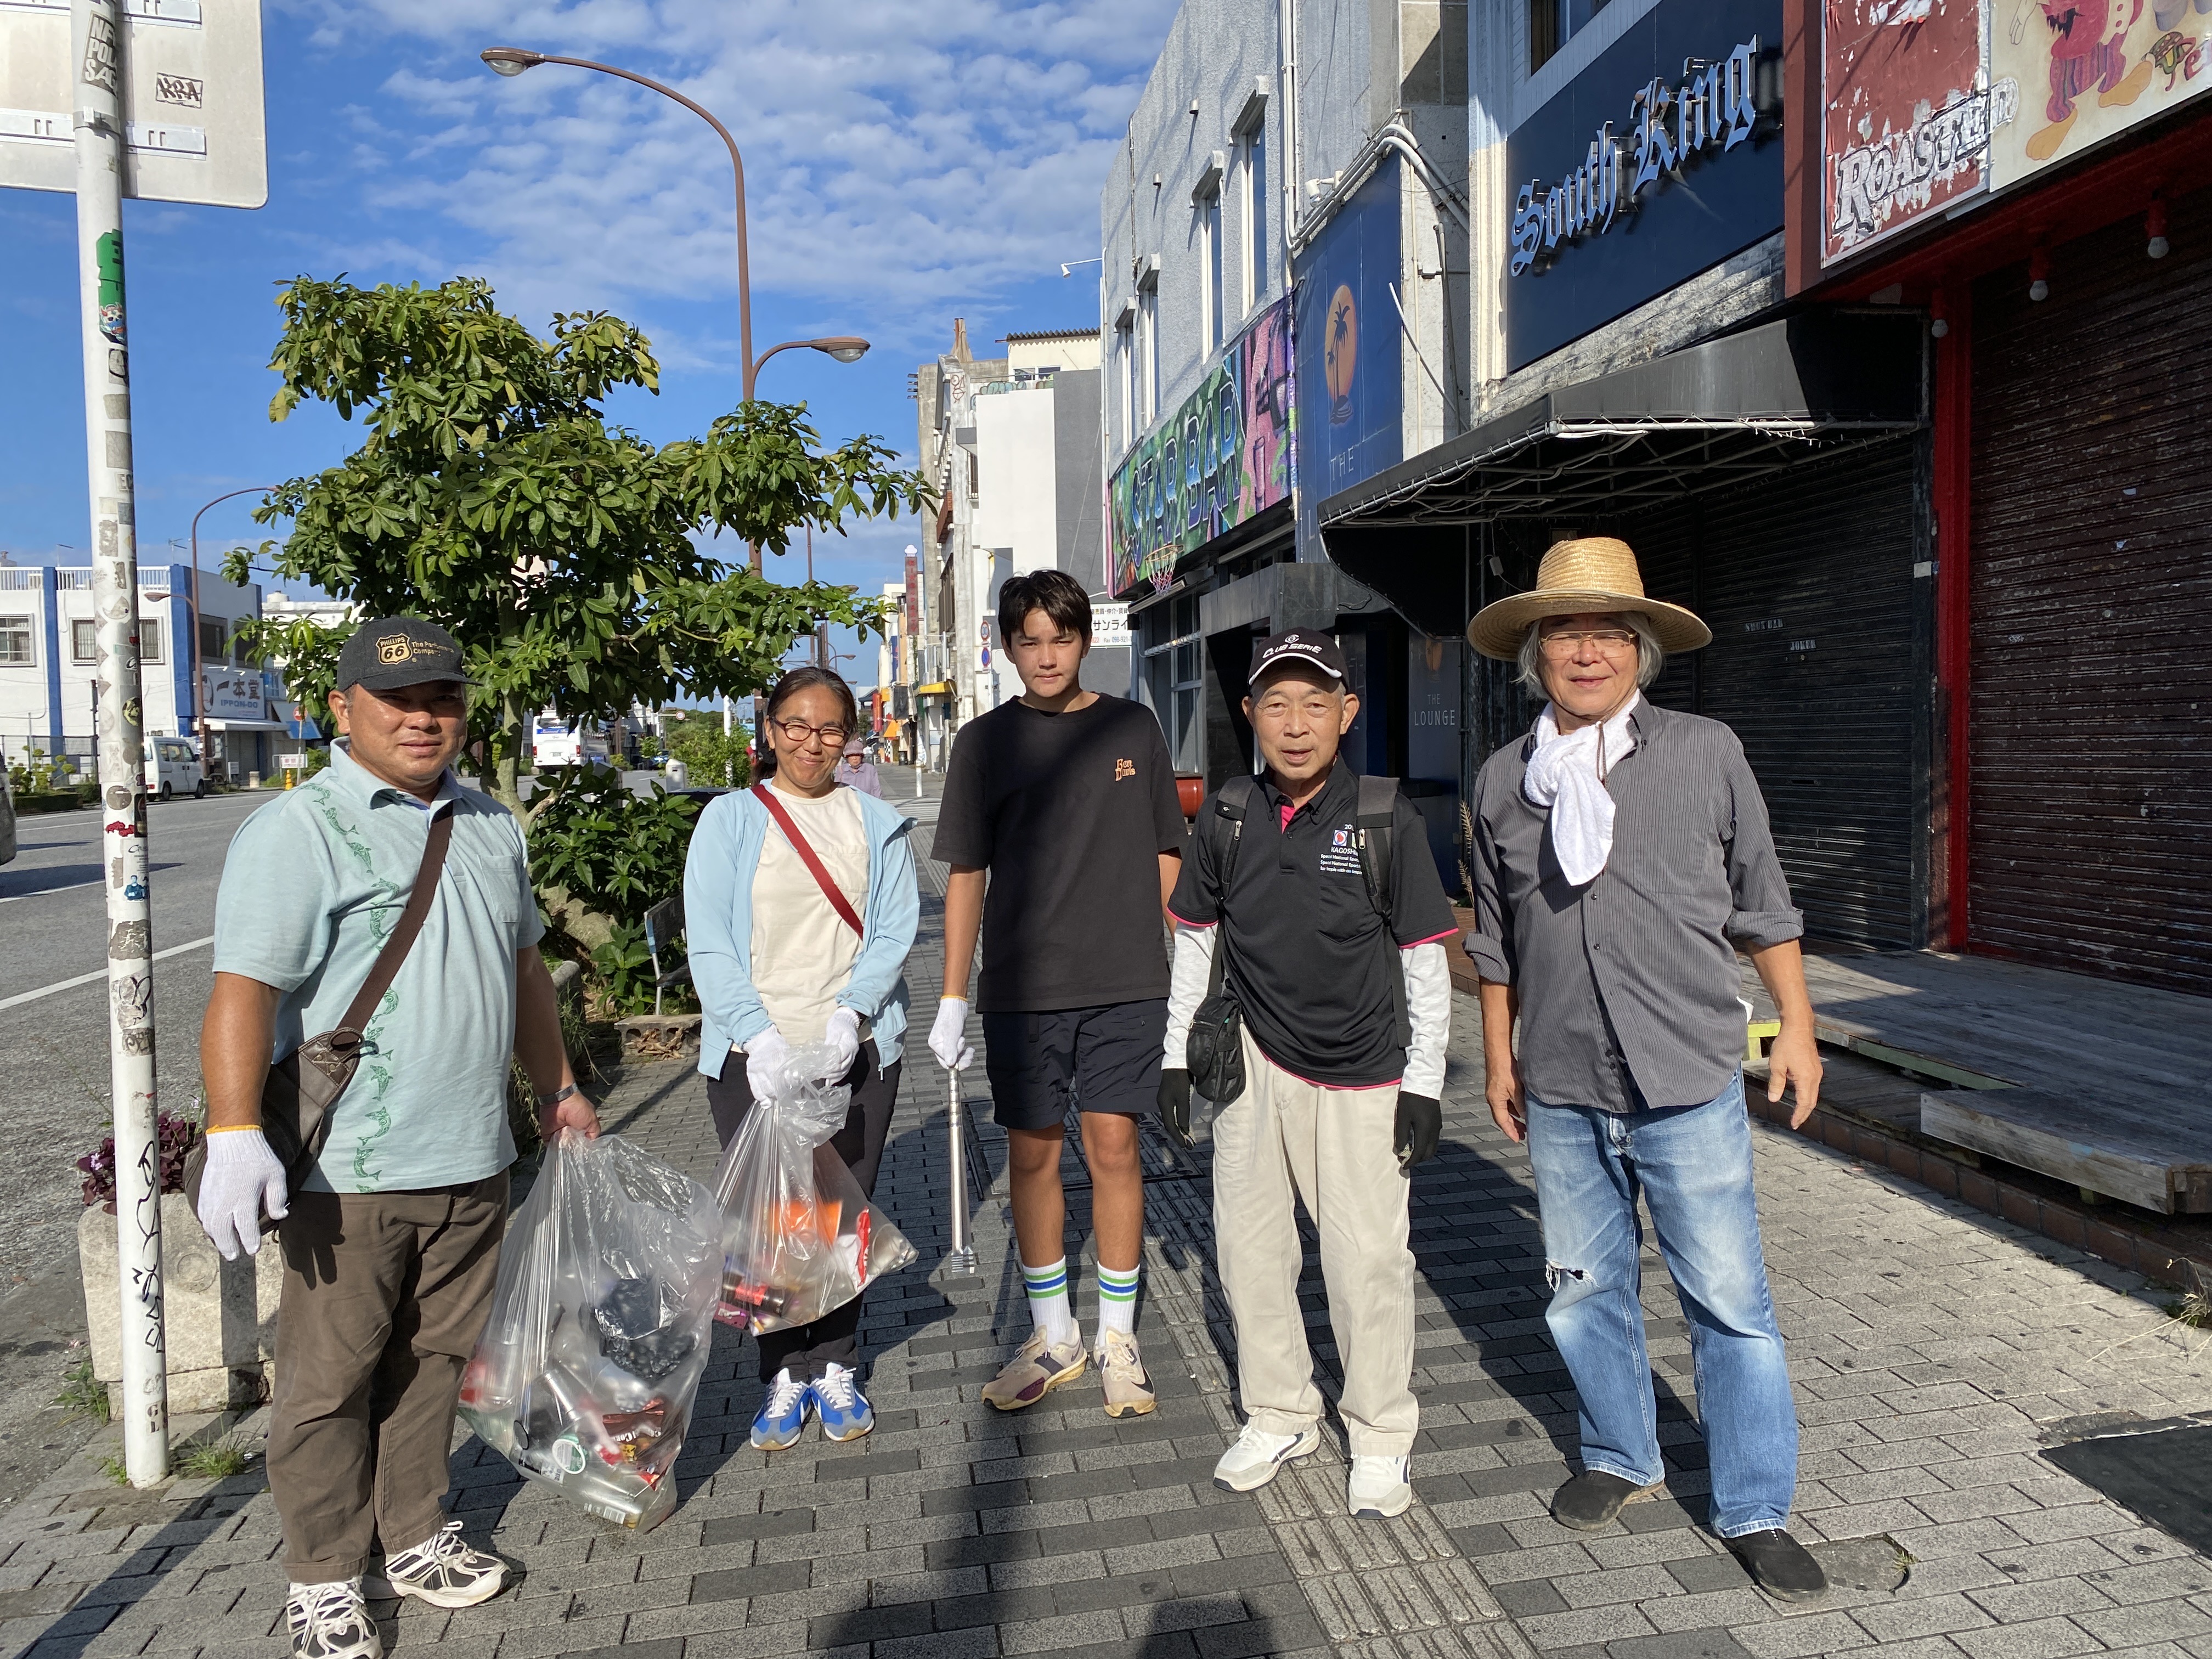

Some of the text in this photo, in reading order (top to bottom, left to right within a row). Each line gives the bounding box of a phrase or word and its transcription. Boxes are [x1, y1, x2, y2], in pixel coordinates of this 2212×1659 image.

[1511, 33, 1760, 278] South King
[1330, 447, 1354, 482] THE
[1131, 381, 1240, 568] STAR BAR
[982, 627, 988, 636] 30
[380, 636, 405, 647] PHILLIPS
[1790, 639, 1816, 651] JOKER
[384, 645, 404, 659] 66
[1262, 643, 1323, 659] CLUB SERIE
[216, 678, 261, 700] 一本堂
[221, 699, 258, 708] IPPON-DO
[1427, 693, 1440, 705] THE
[1414, 709, 1455, 726] LOUNGE
[1116, 758, 1133, 769] Ben
[1115, 768, 1136, 782] Davis
